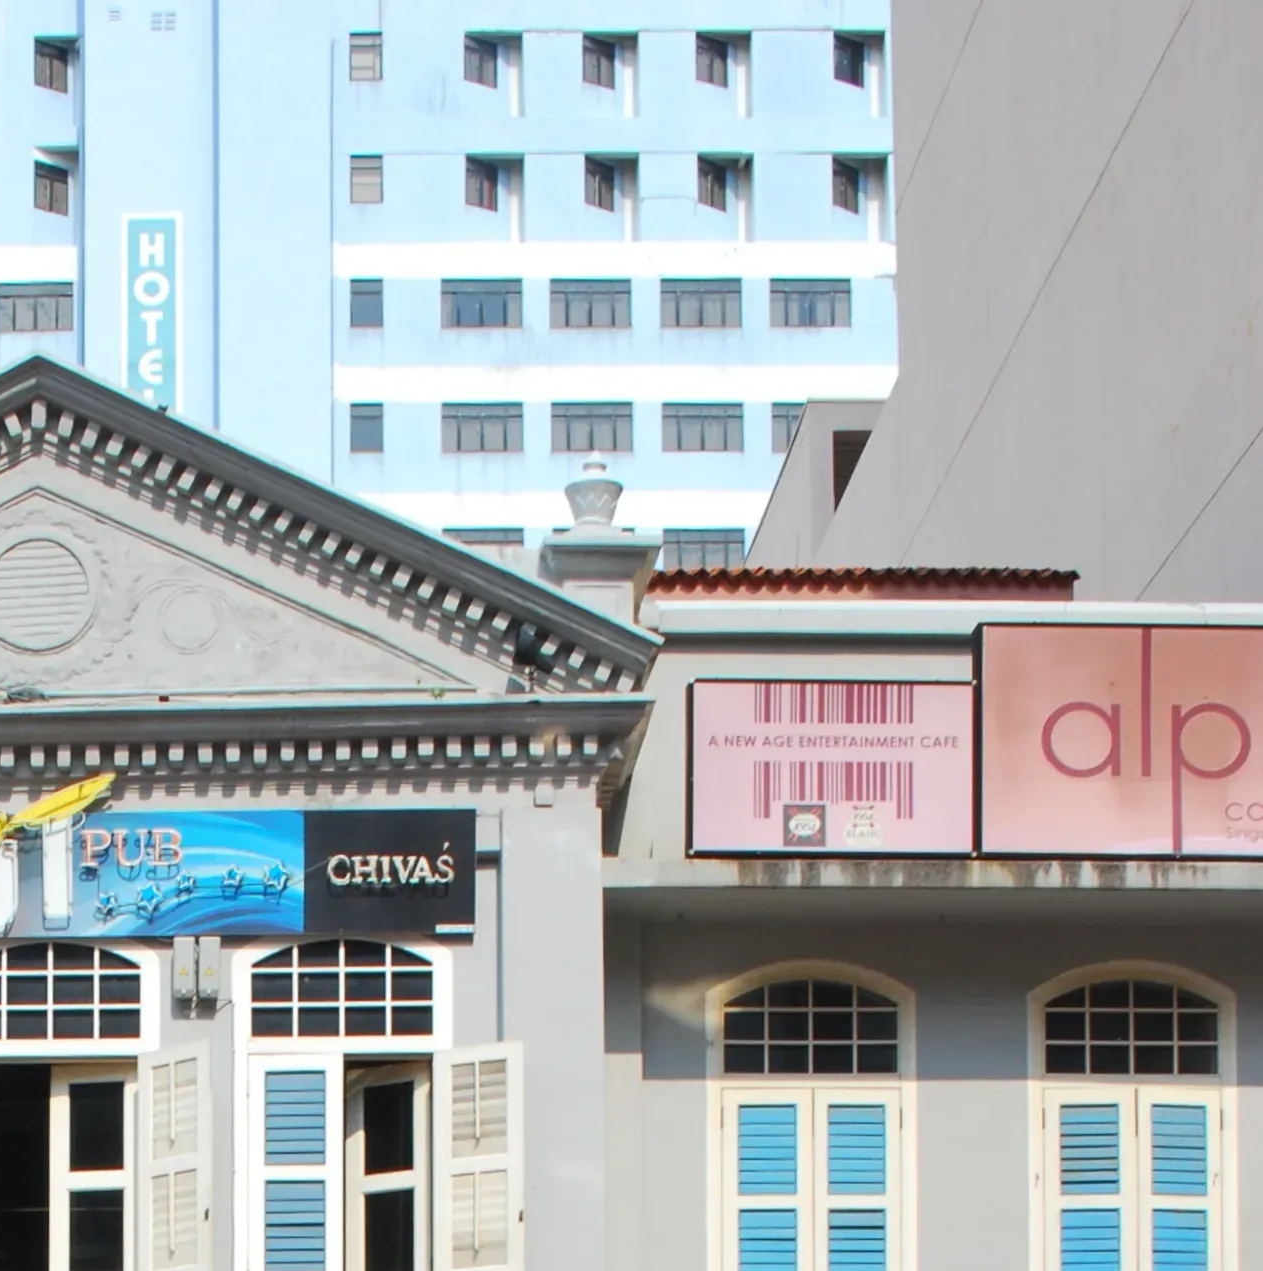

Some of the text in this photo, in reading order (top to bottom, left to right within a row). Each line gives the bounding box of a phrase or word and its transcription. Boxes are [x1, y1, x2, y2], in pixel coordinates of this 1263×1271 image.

[133, 232, 171, 400] HOTE
[708, 736, 959, 748] A NEW AGE ENTERTAINMENT CAFE
[80, 829, 184, 869] PUB
[326, 848, 455, 886] CHIVAS
